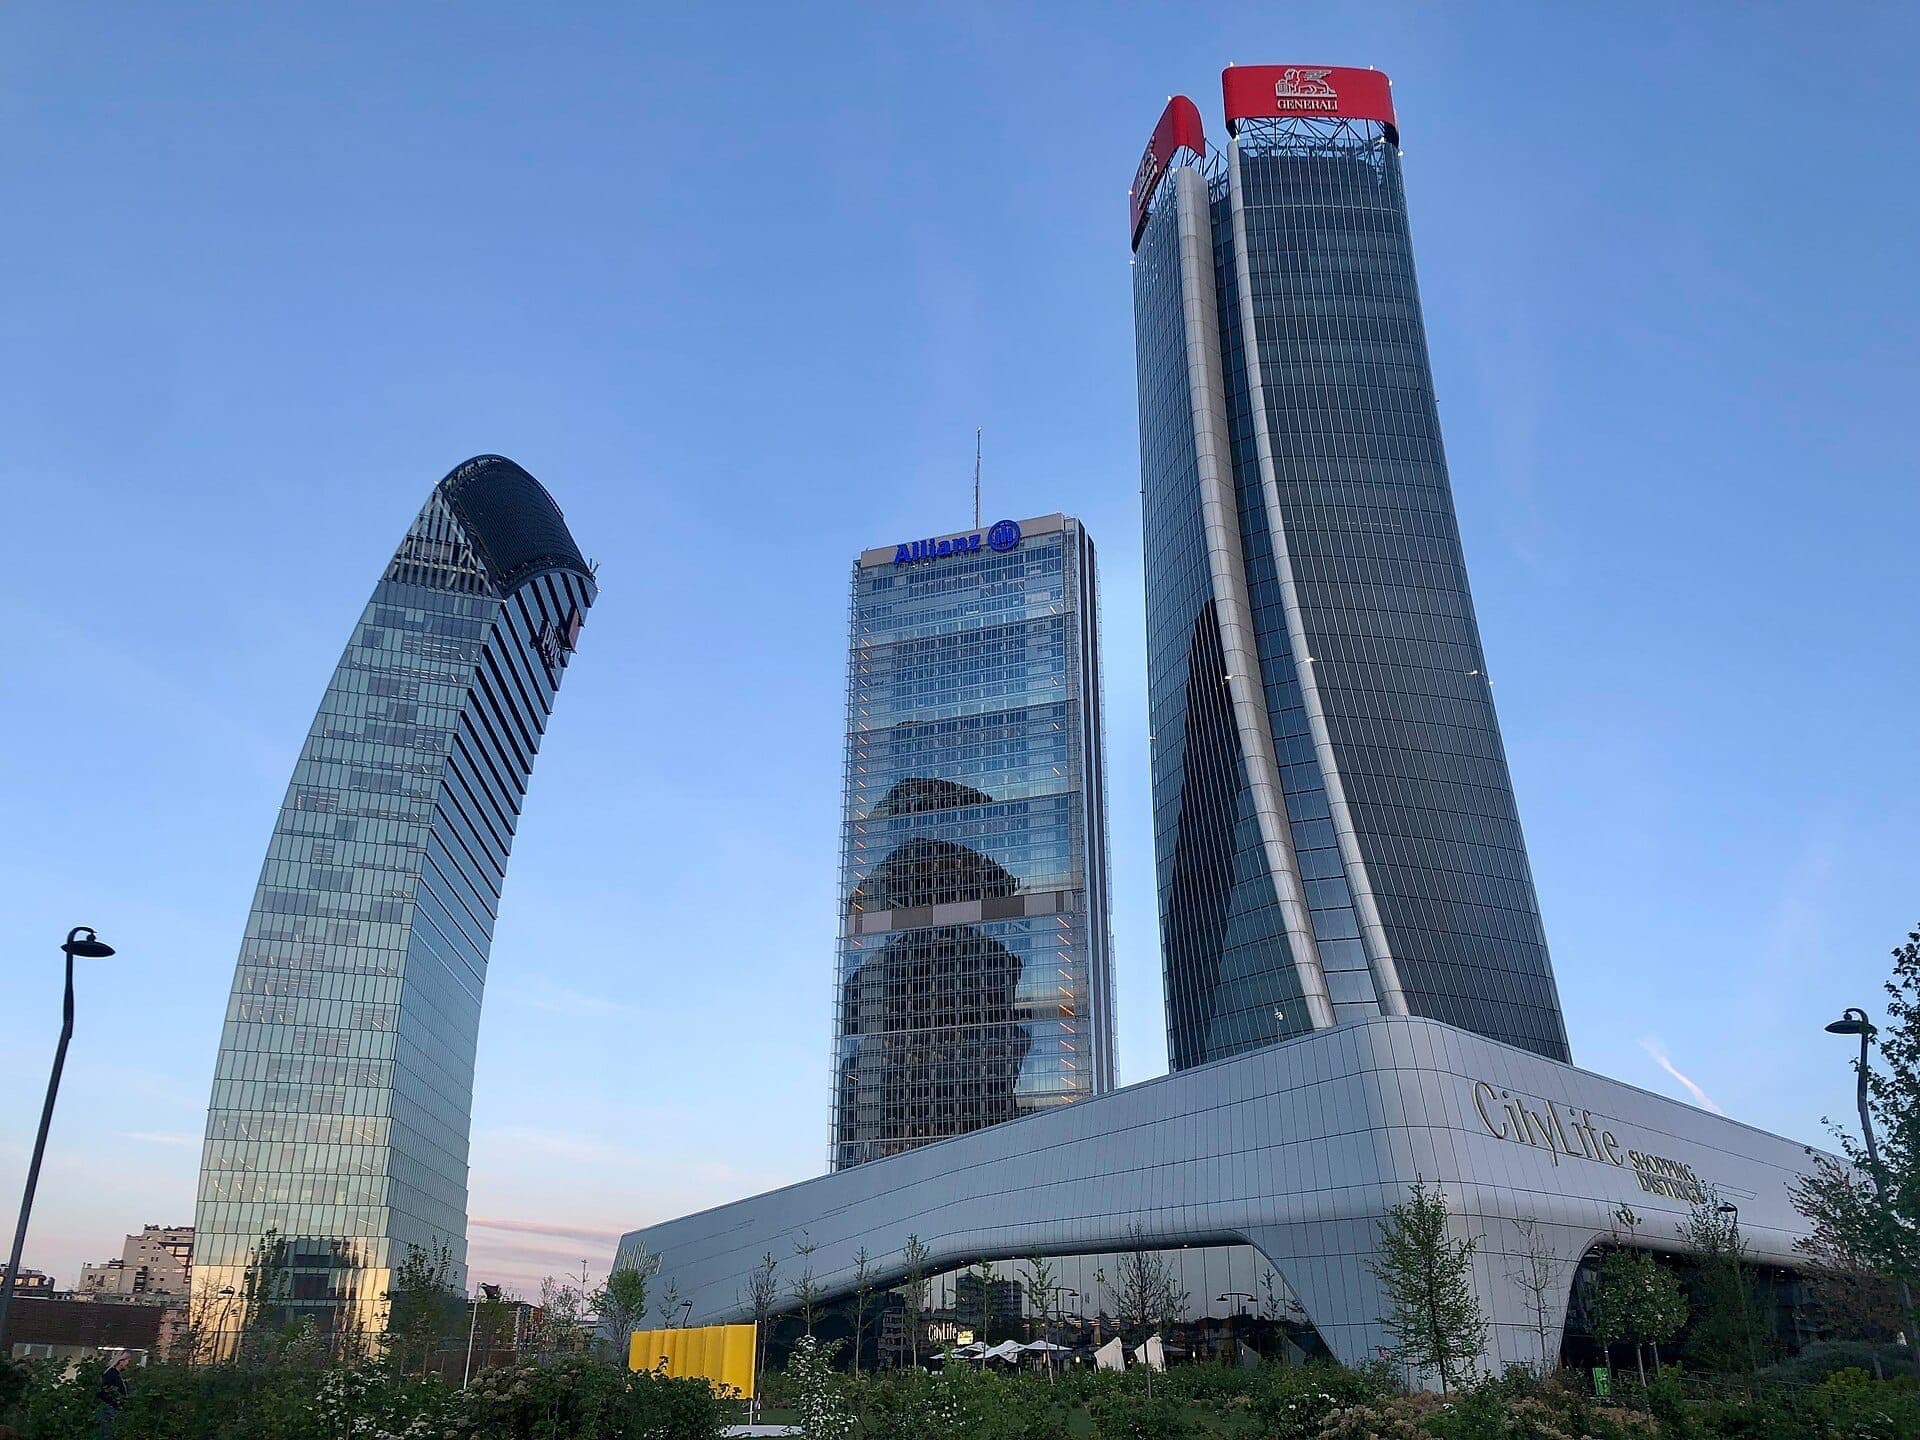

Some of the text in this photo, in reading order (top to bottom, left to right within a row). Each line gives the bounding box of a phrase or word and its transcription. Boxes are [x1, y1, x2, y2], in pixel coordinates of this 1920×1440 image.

[1277, 99, 1338, 110] GENERALI
[894, 534, 981, 565] Allianz
[1472, 1080, 1623, 1167] CityLife
[1628, 1149, 1697, 1182] SHOPPING
